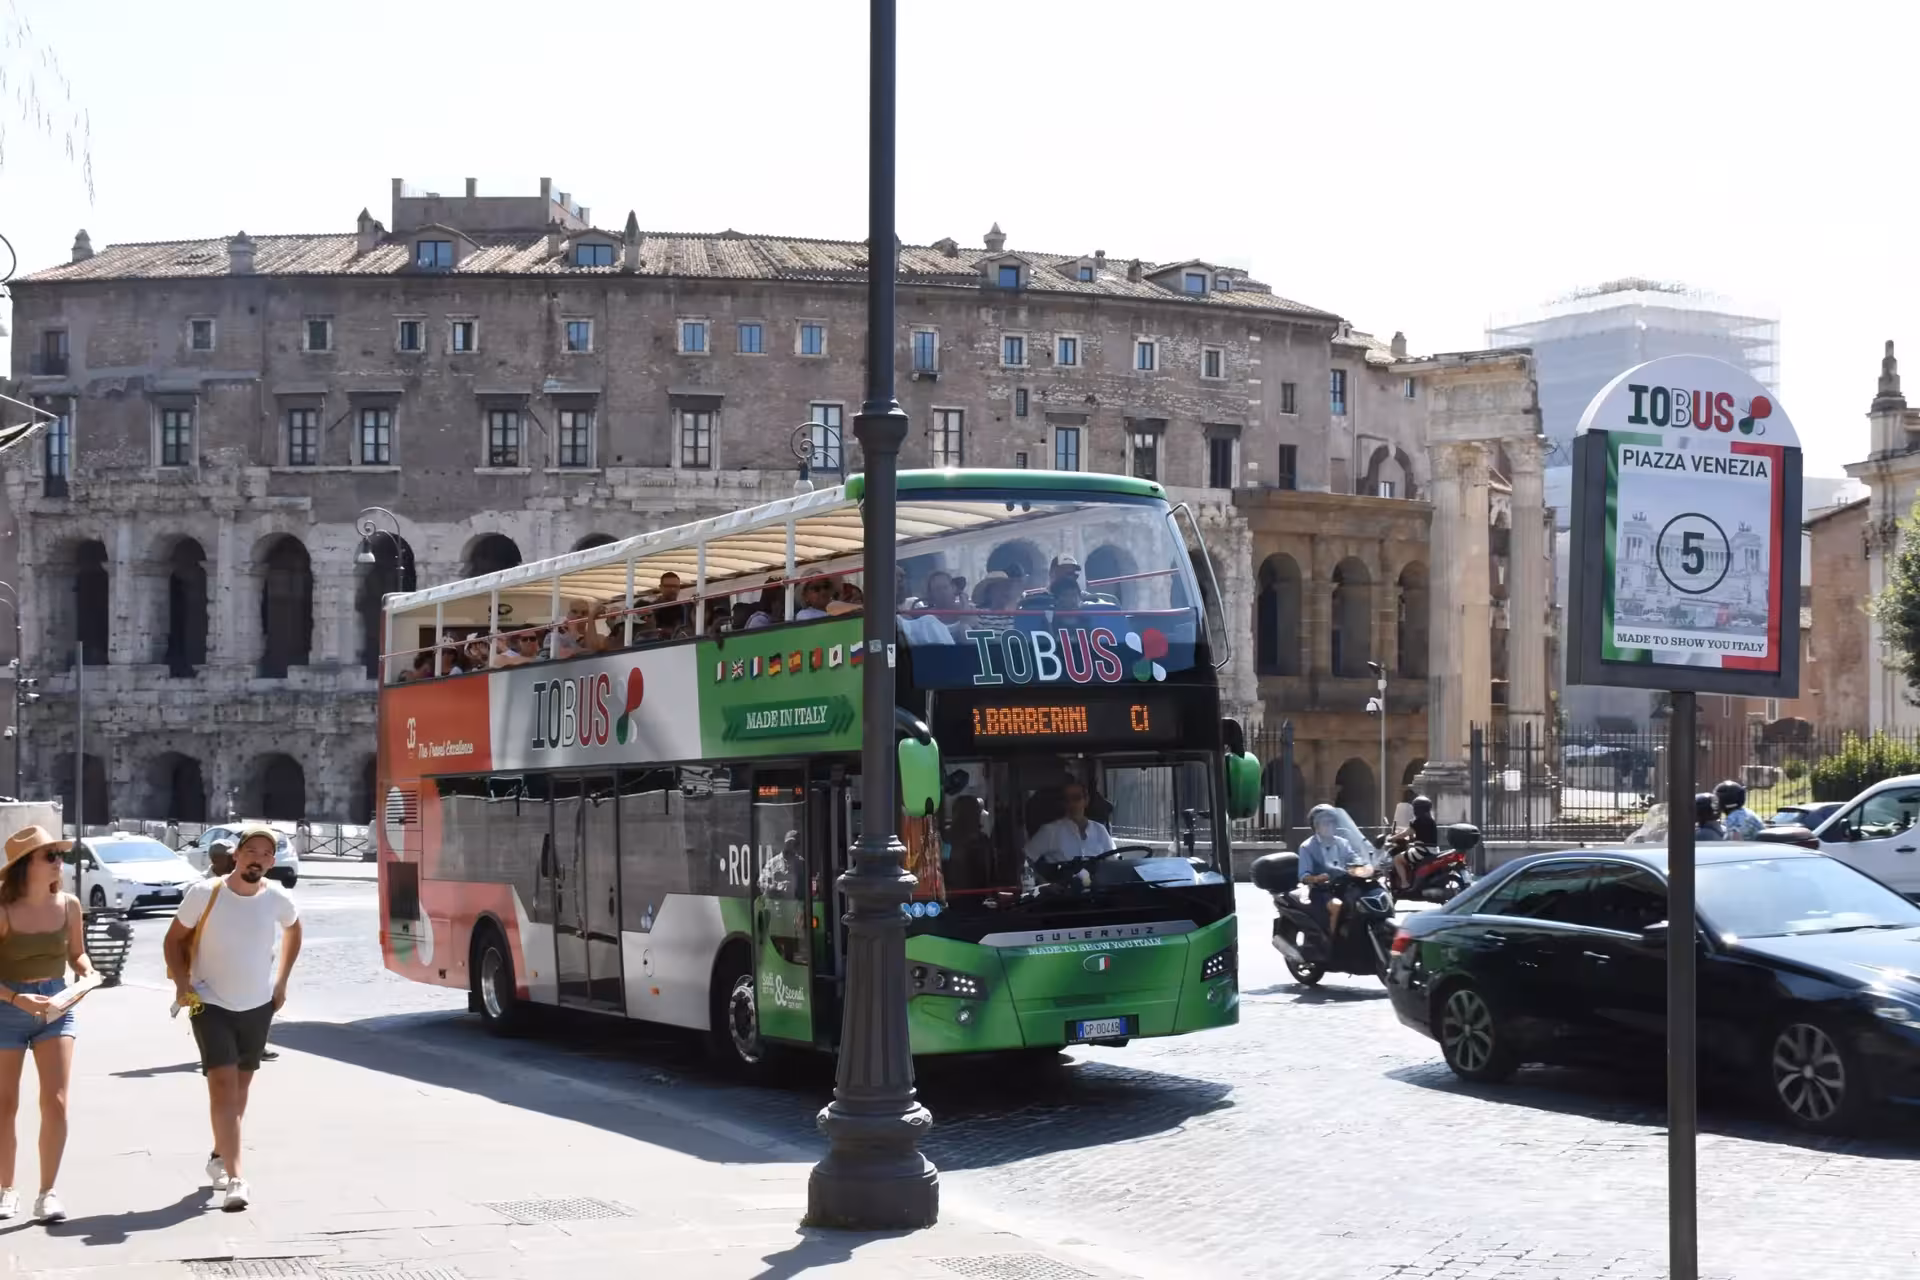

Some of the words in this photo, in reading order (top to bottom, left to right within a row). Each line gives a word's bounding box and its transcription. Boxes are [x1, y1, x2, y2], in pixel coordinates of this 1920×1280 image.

[1627, 384, 1735, 433] IOBUS
[1622, 449, 1686, 471] PIAZZA
[1691, 456, 1768, 478] VENEZIA
[1681, 531, 1705, 576] 5
[966, 627, 1123, 686] IOBUS
[1617, 633, 1650, 644] MADE
[1653, 636, 1668, 646] TO
[1670, 636, 1704, 648] SHOW
[1707, 640, 1730, 650] YOU
[1732, 642, 1764, 652] ITALY
[532, 672, 611, 751] IOBUS
[746, 710, 778, 730] MADE
[780, 709, 792, 728] IN
[794, 706, 828, 726] ITALY
[1028, 945, 1062, 956] MADE
[1062, 944, 1078, 954] TO
[1079, 940, 1110, 952] SHOW
[1112, 939, 1132, 950] YOU
